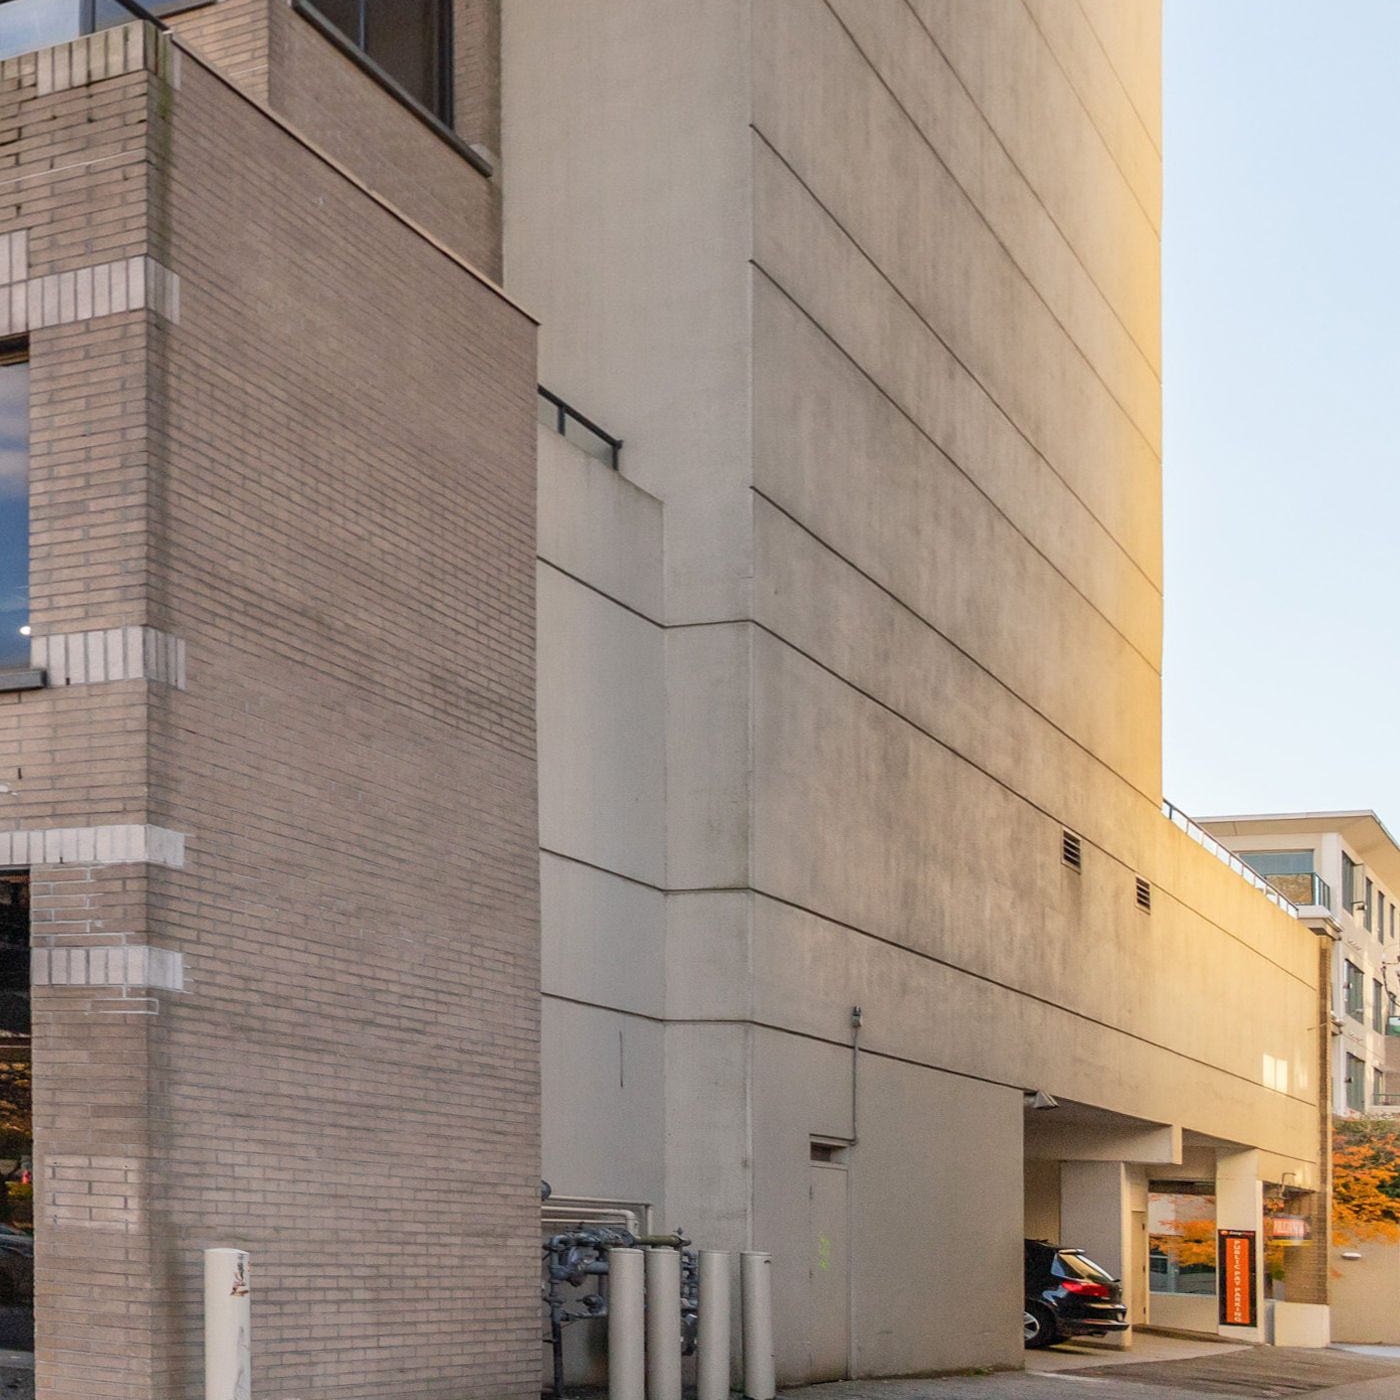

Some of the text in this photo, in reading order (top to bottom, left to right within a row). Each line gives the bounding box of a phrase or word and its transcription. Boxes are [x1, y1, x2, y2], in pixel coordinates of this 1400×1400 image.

[1233, 1240, 1241, 1270] PUBLIC
[1233, 1271, 1241, 1285] PAY
[1233, 1287, 1243, 1323] PARKING
